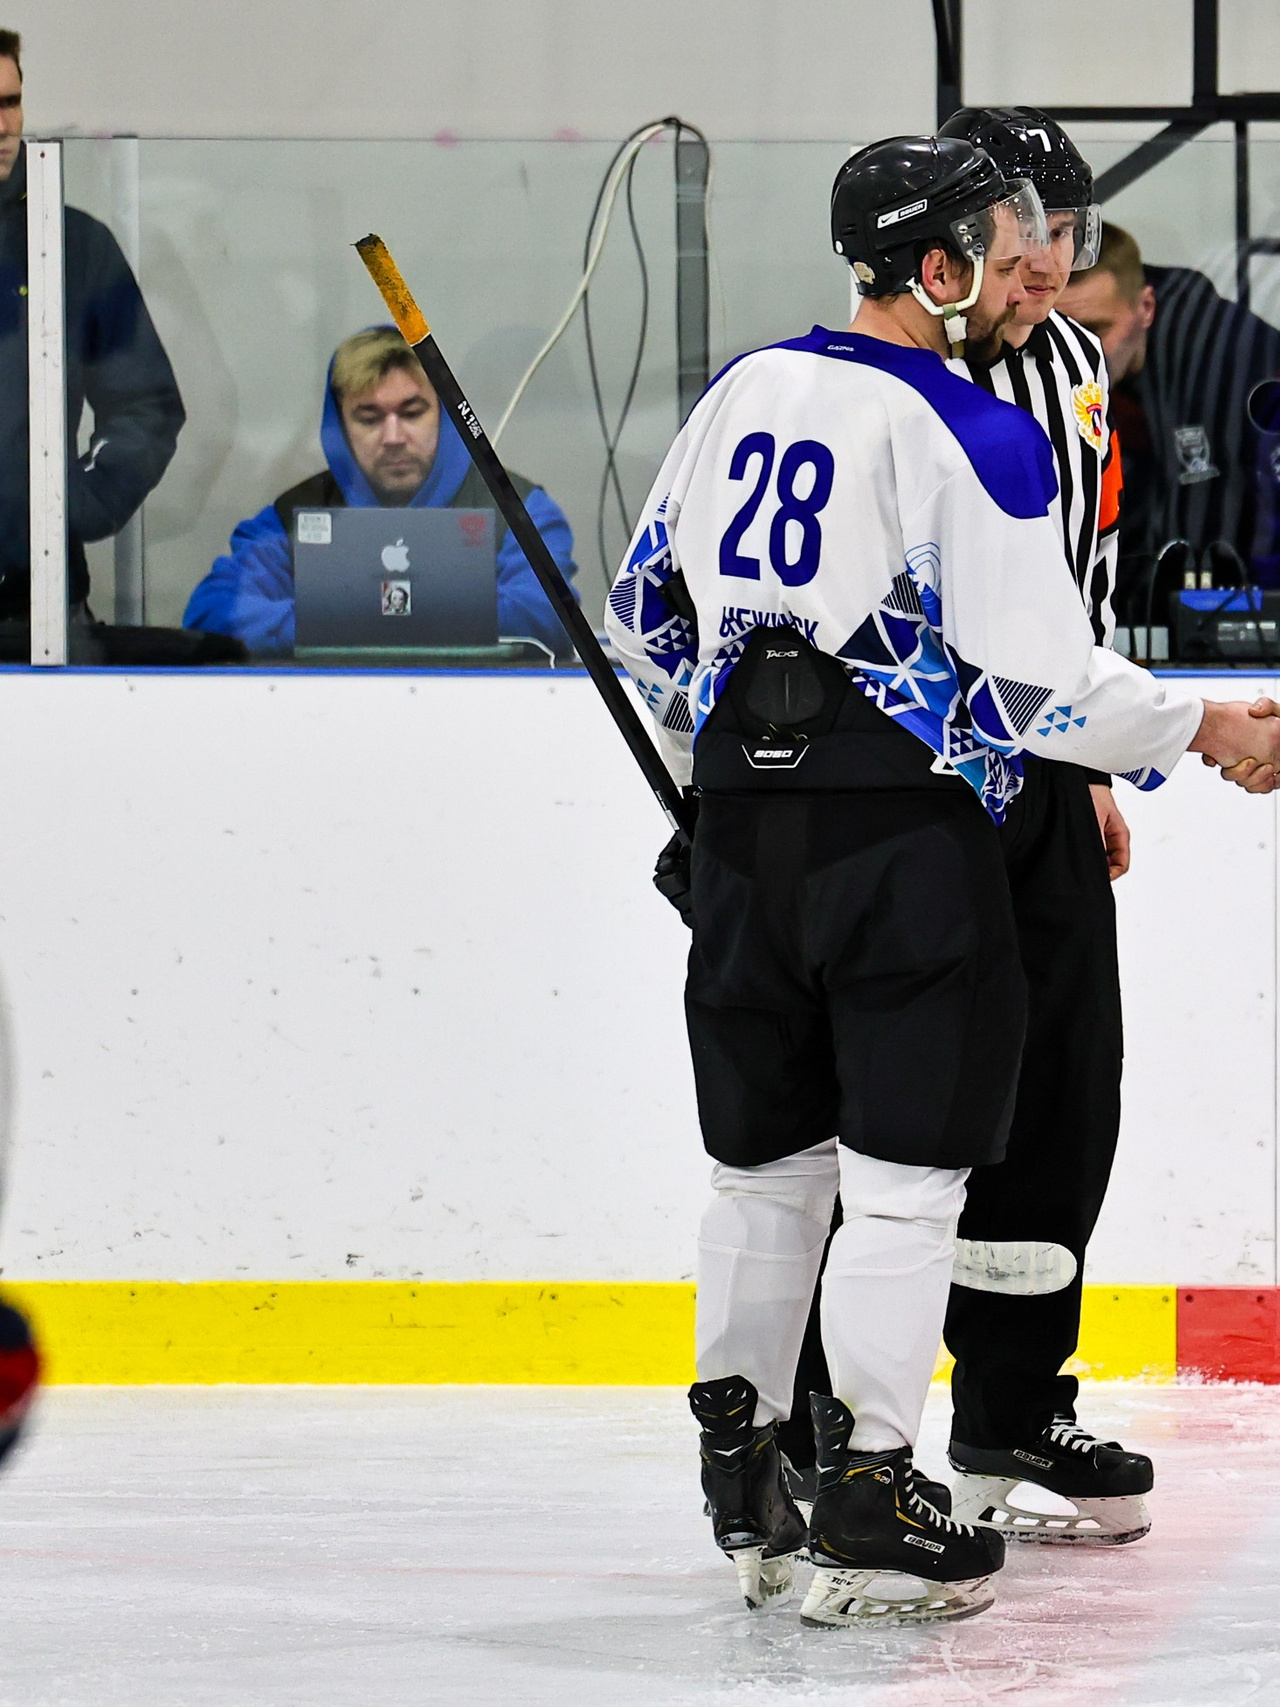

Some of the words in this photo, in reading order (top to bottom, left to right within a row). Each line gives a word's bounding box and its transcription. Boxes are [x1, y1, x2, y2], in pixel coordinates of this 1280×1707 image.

[1026, 128, 1052, 152] 7
[899, 202, 924, 217] BAUER
[718, 431, 835, 587] 28
[766, 650, 799, 660] TACKS
[1013, 1450, 1051, 1467] BAUER
[906, 1536, 943, 1552] BAUER
